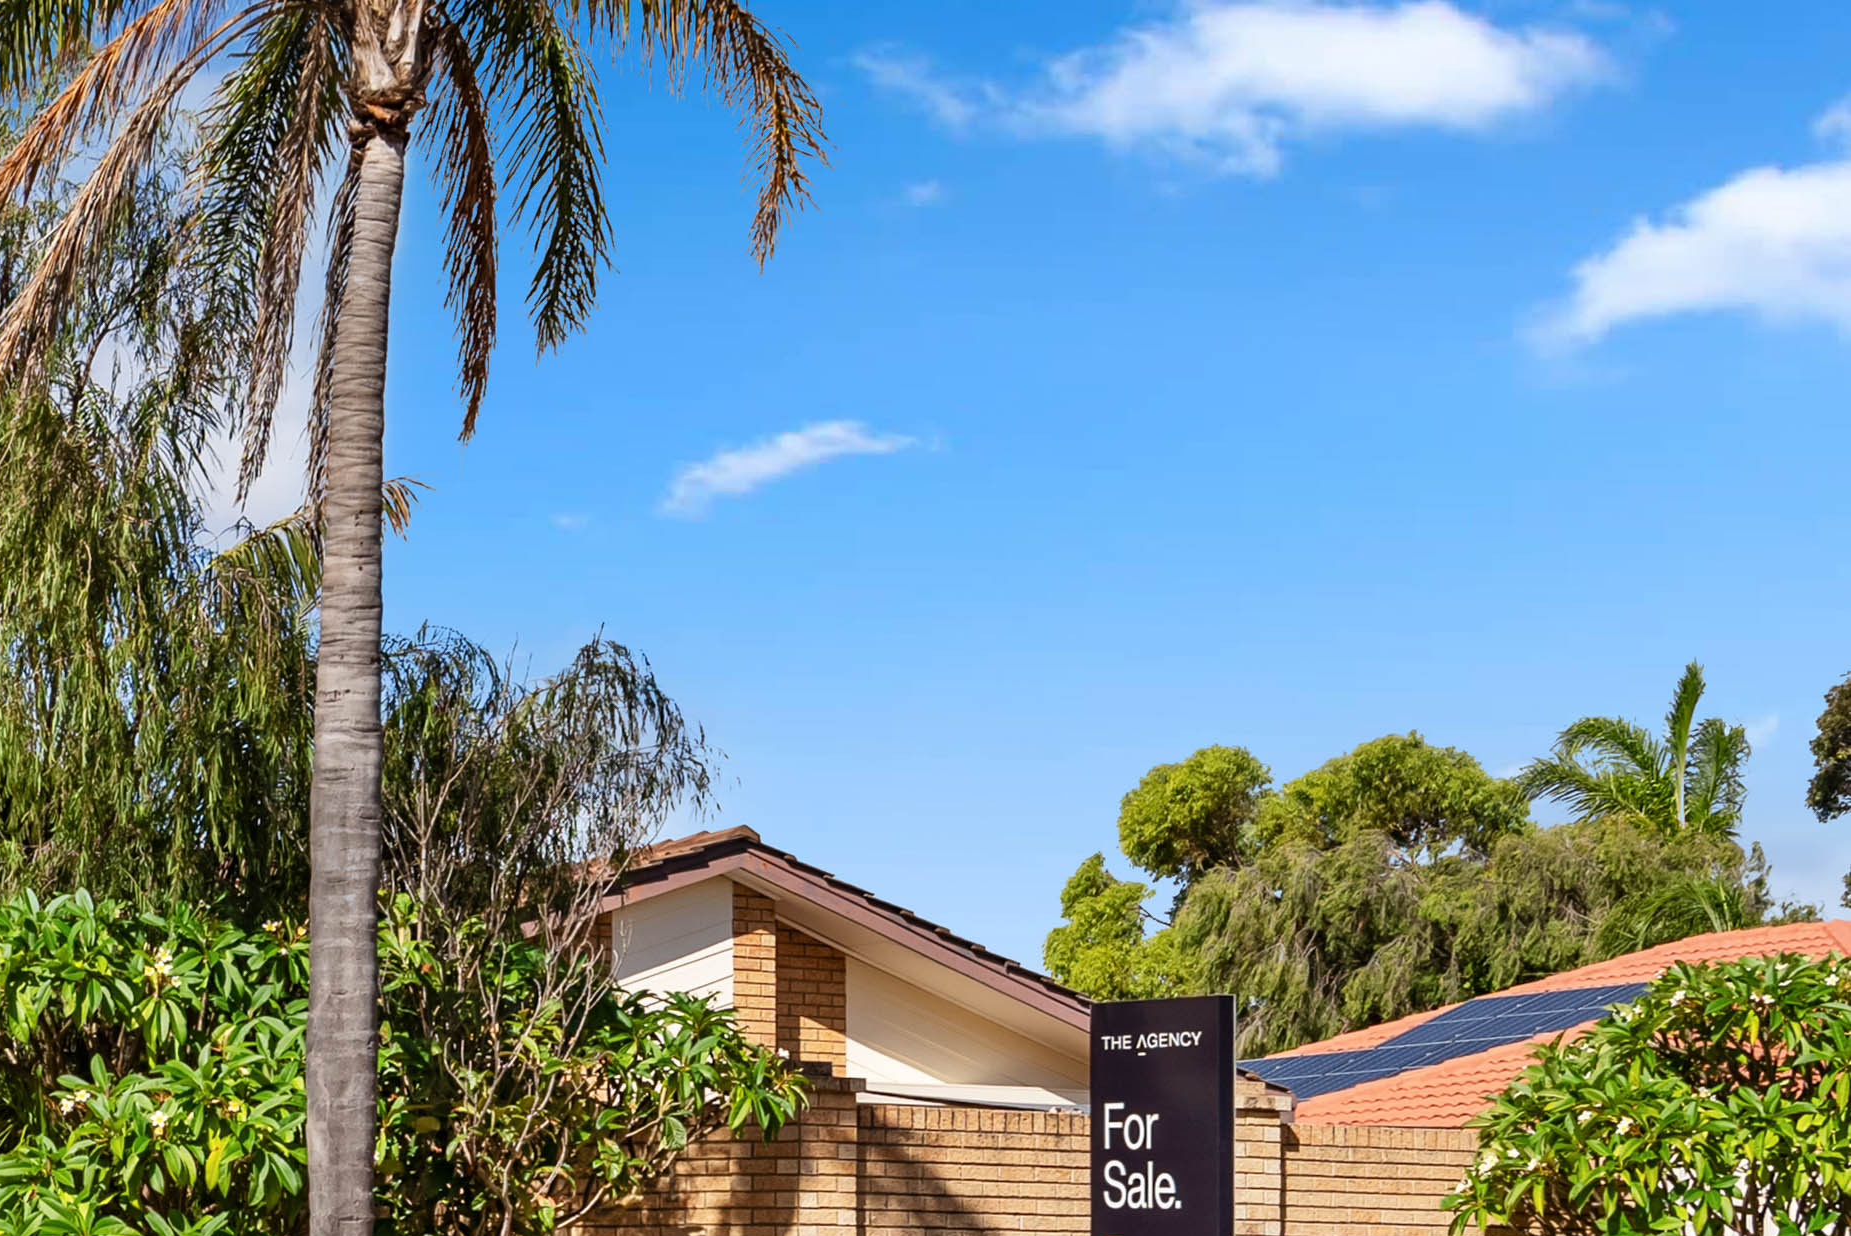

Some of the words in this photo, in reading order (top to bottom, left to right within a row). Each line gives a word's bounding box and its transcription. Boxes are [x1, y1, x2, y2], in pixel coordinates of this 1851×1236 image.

[1101, 1035, 1132, 1050] THE
[1135, 1031, 1203, 1056] AGENCY
[1103, 1102, 1159, 1150] For
[1103, 1159, 1182, 1210] Sale.
